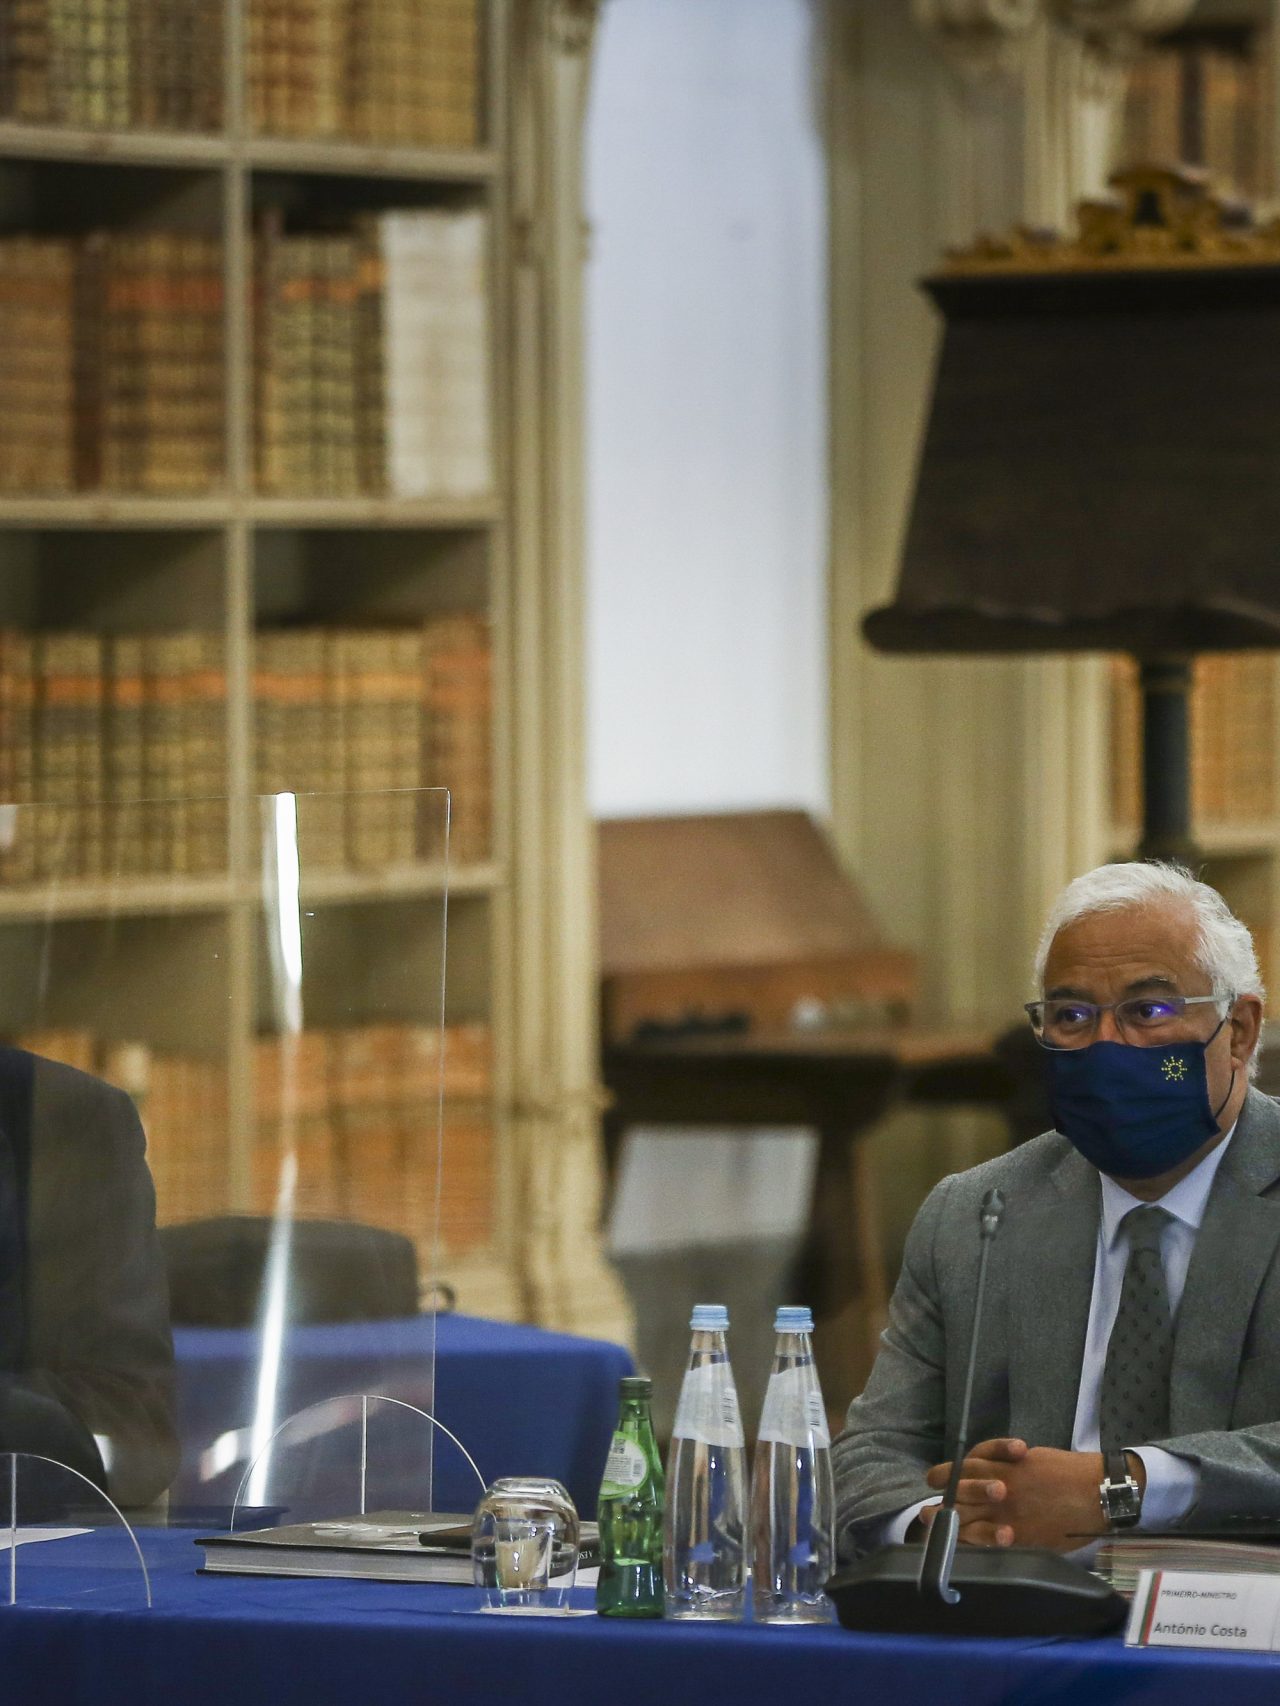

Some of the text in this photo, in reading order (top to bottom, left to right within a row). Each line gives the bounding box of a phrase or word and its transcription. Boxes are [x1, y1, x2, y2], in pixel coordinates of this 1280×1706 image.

[1161, 1590, 1237, 1600] PRIMEIRO-MINISTRO
[1154, 1622, 1248, 1638] António Costa
